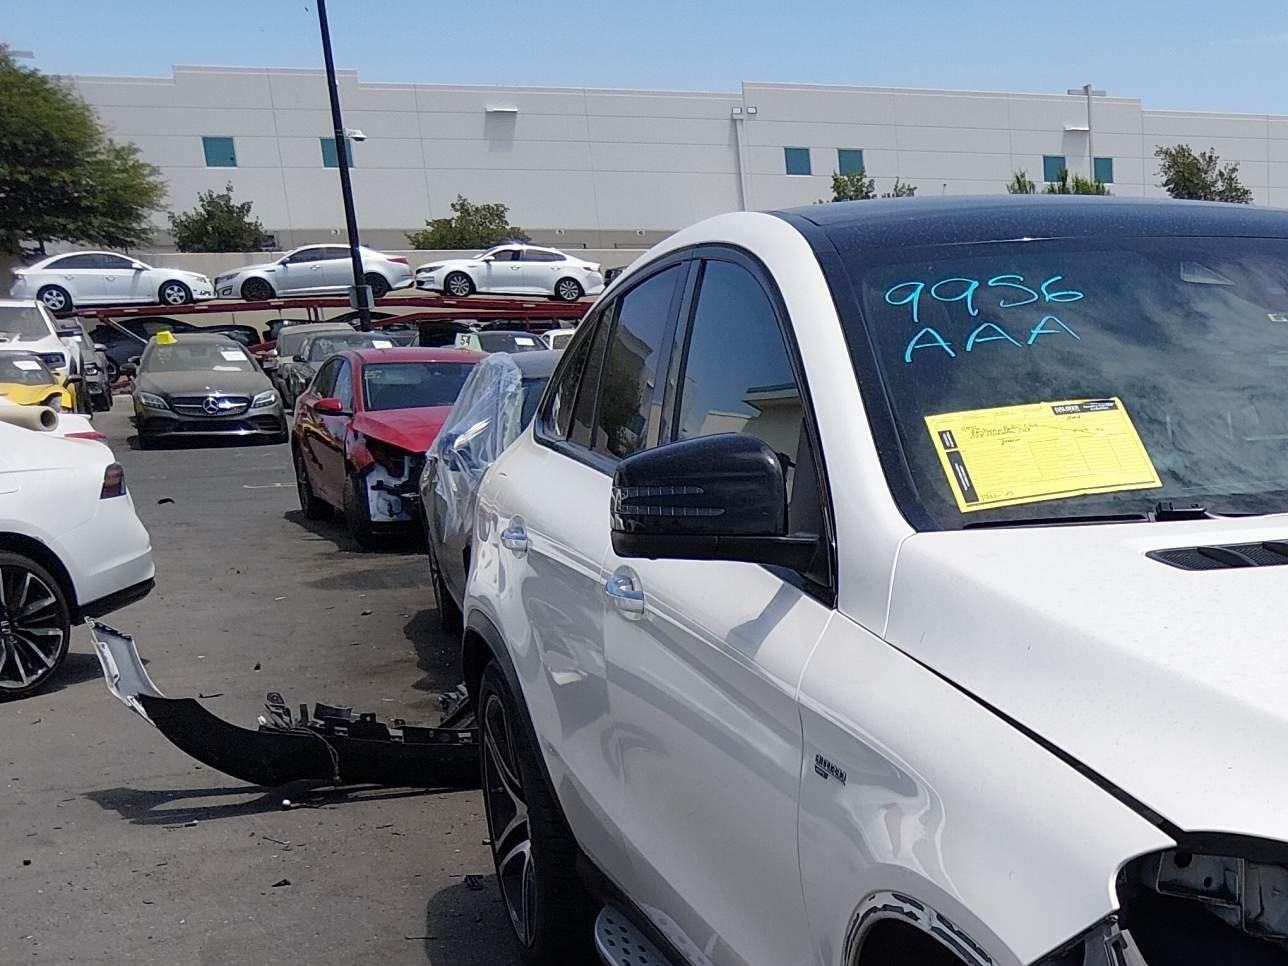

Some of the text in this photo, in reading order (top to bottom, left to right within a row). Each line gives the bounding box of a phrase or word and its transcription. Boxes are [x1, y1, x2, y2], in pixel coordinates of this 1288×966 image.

[885, 275, 1084, 322] 9956
[459, 335, 471, 347] 54
[904, 316, 1080, 363] AAA
